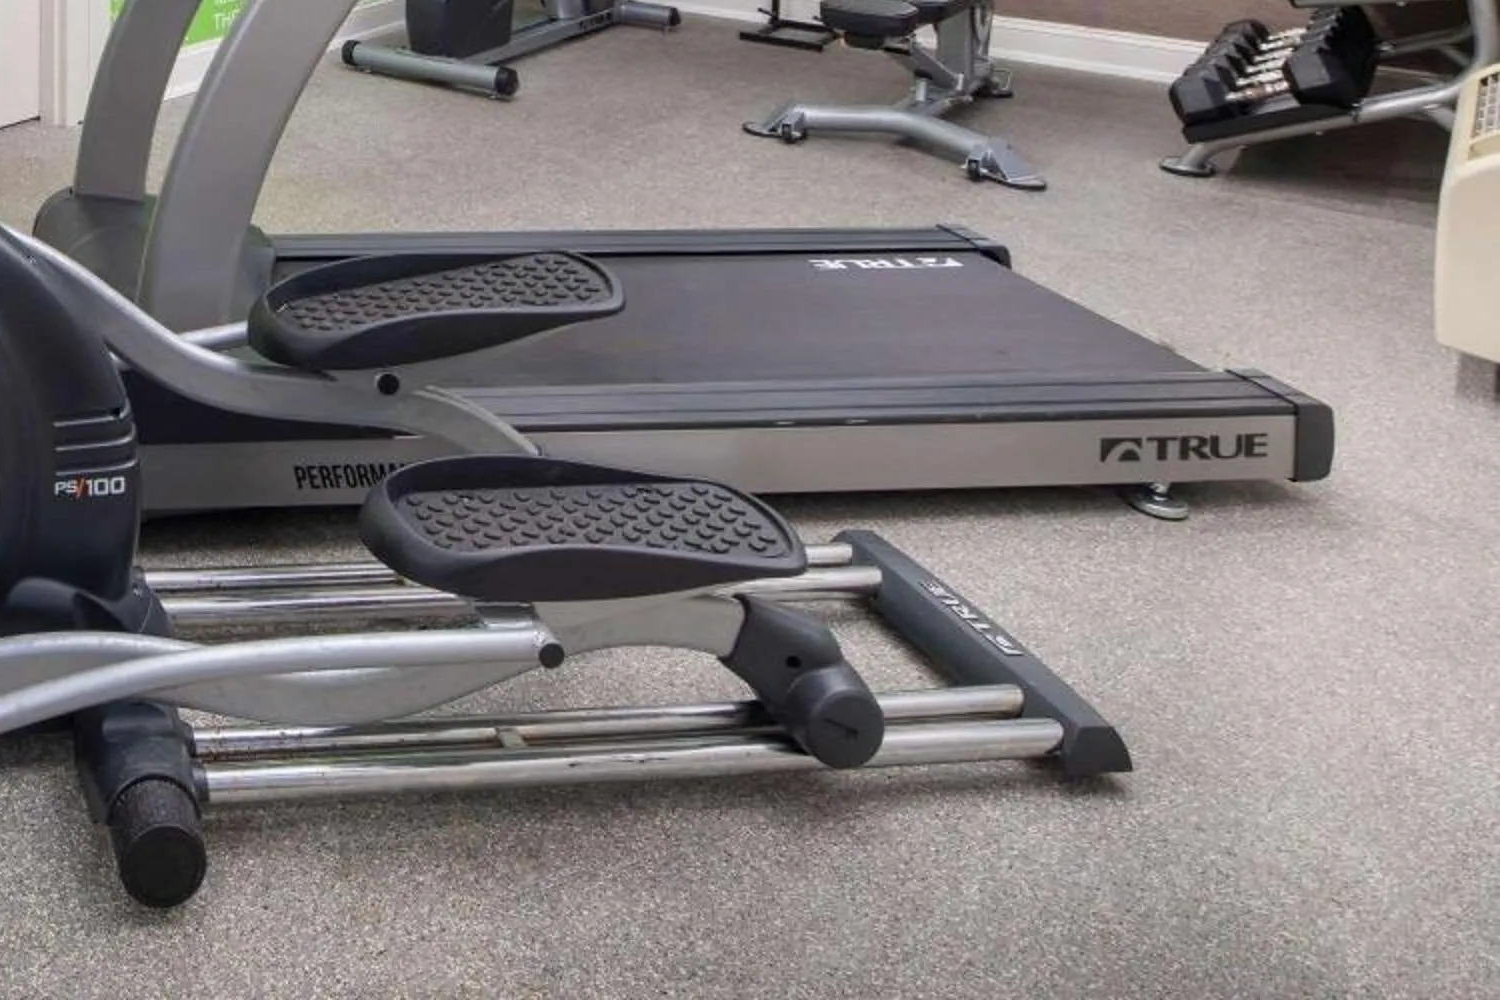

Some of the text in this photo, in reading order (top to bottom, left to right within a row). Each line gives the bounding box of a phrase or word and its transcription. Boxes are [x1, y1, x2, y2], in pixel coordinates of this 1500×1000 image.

[1146, 433, 1269, 461] TRUE
[54, 476, 125, 499] PS/100
[293, 463, 403, 490] PERFORM
